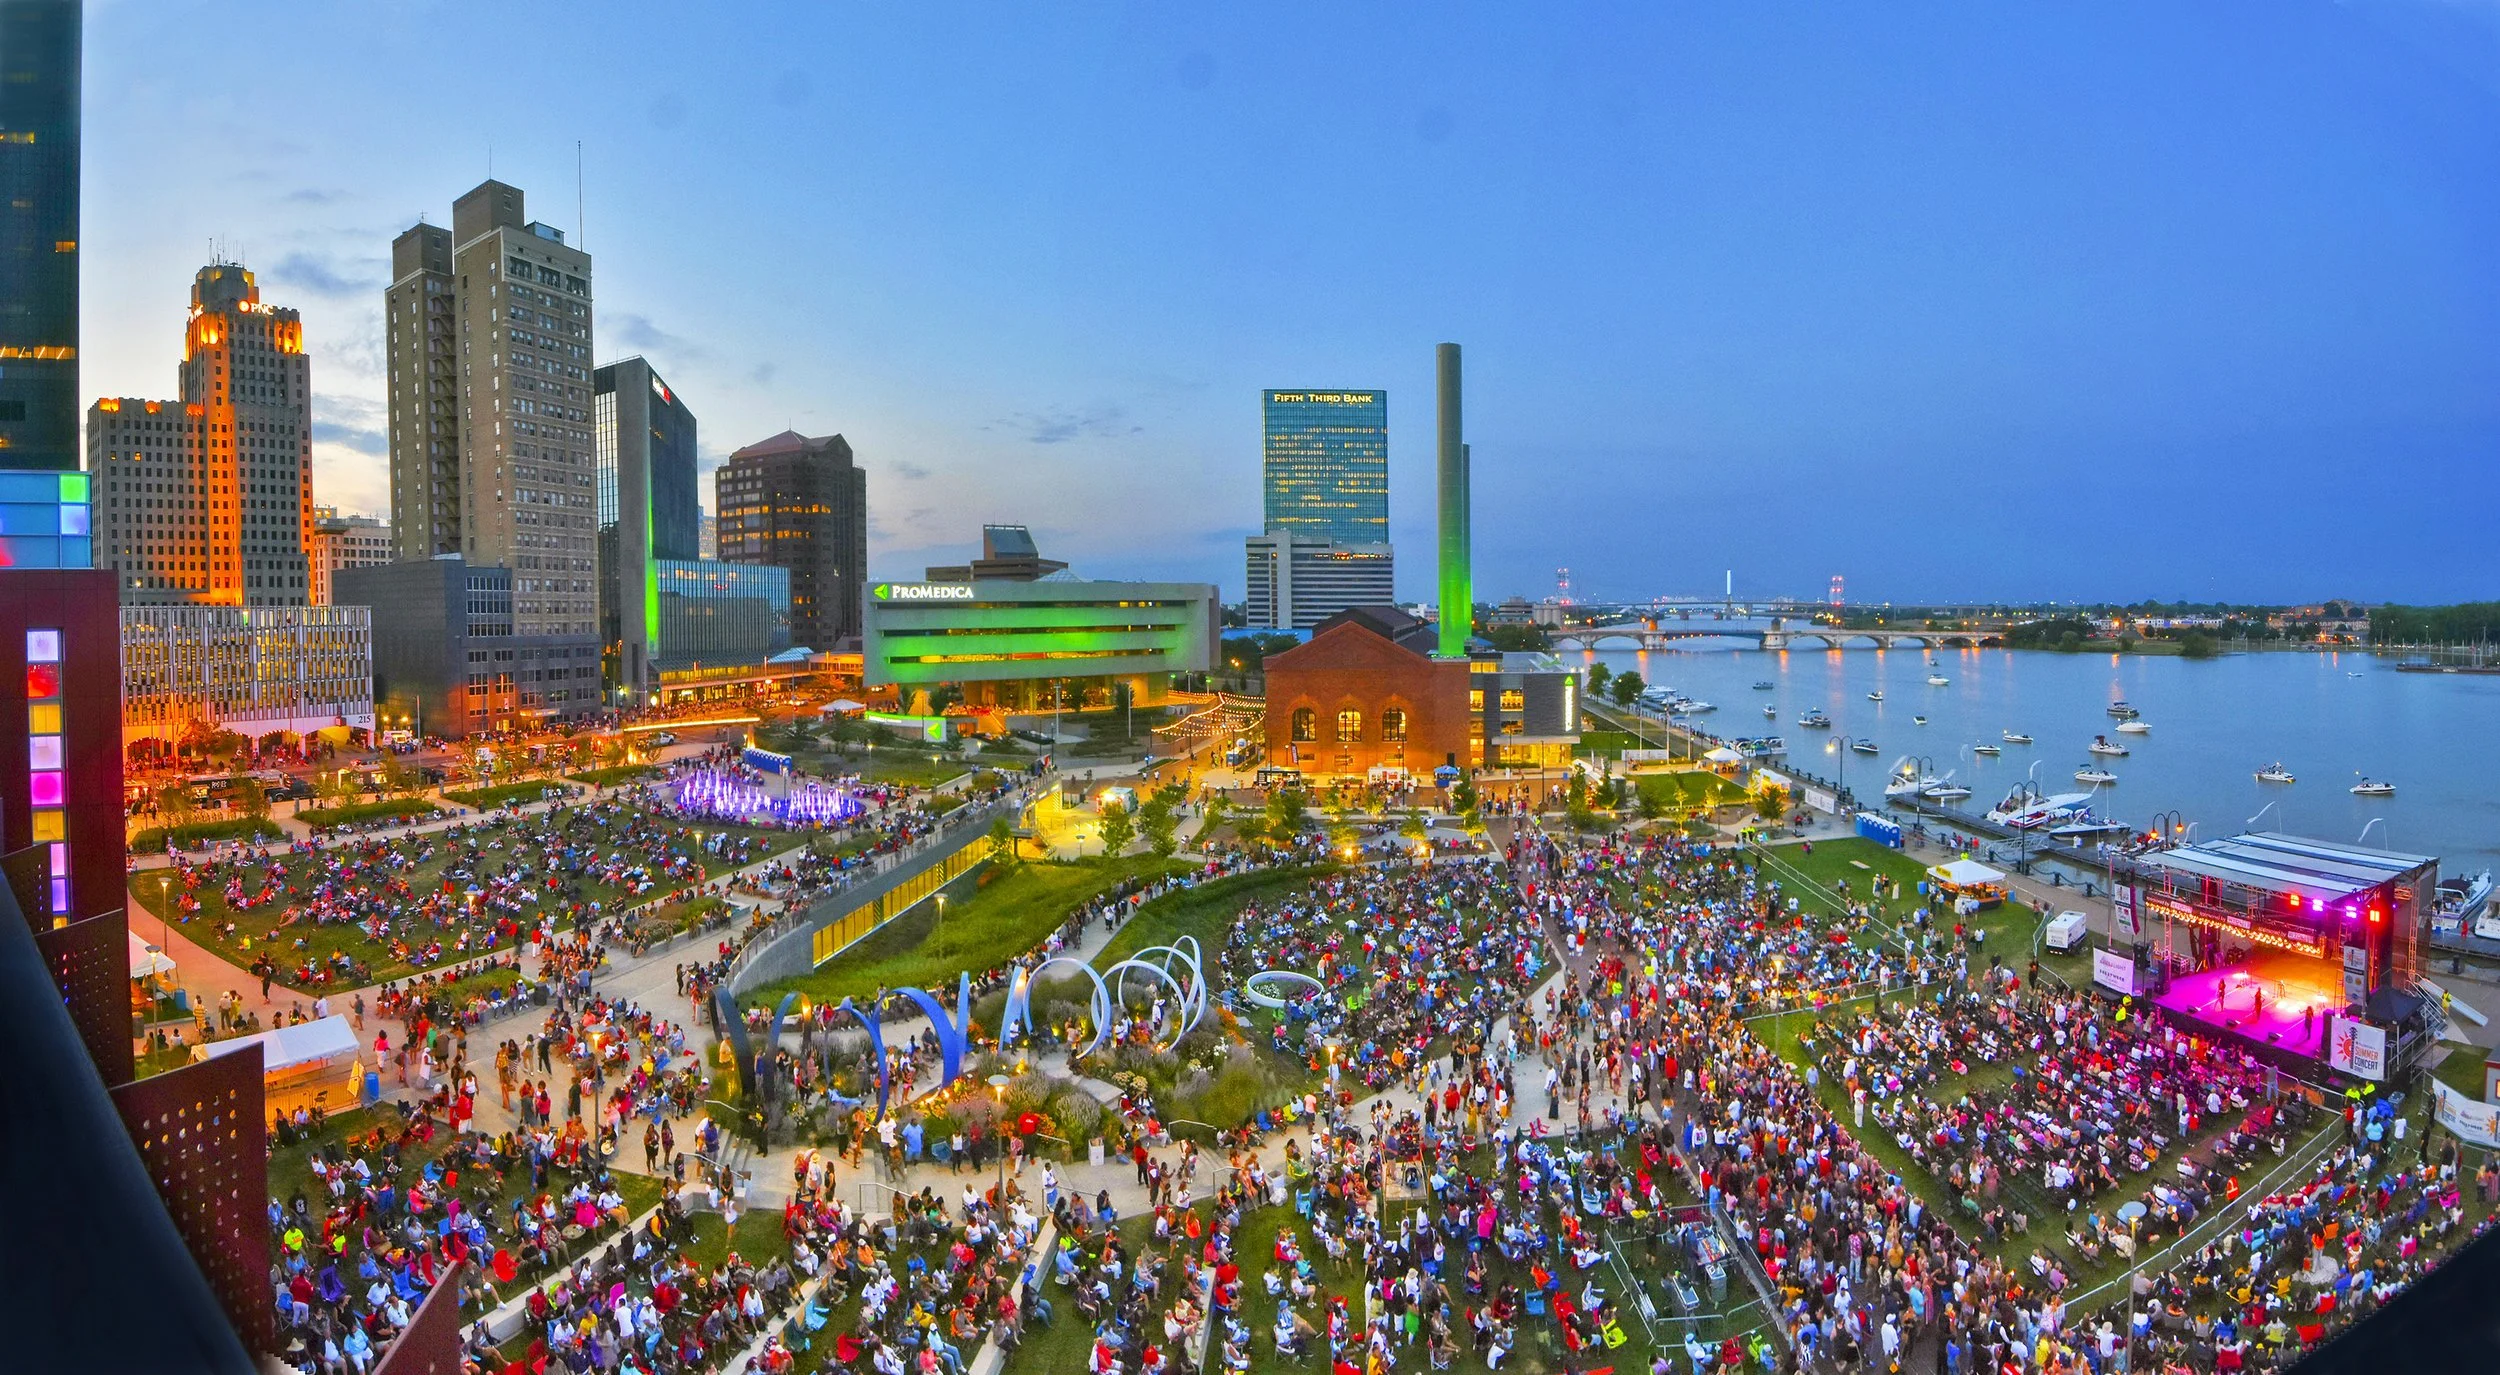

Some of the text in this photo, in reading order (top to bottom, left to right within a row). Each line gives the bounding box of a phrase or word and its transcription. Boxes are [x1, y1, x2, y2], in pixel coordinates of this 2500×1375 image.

[251, 303, 274, 316] PNC
[1274, 393, 1373, 403] FIFTH THIRD BANK
[358, 715, 371, 724] 215
[2355, 1046, 2379, 1061] SUMMER
[2354, 1056, 2378, 1071] CONCERT
